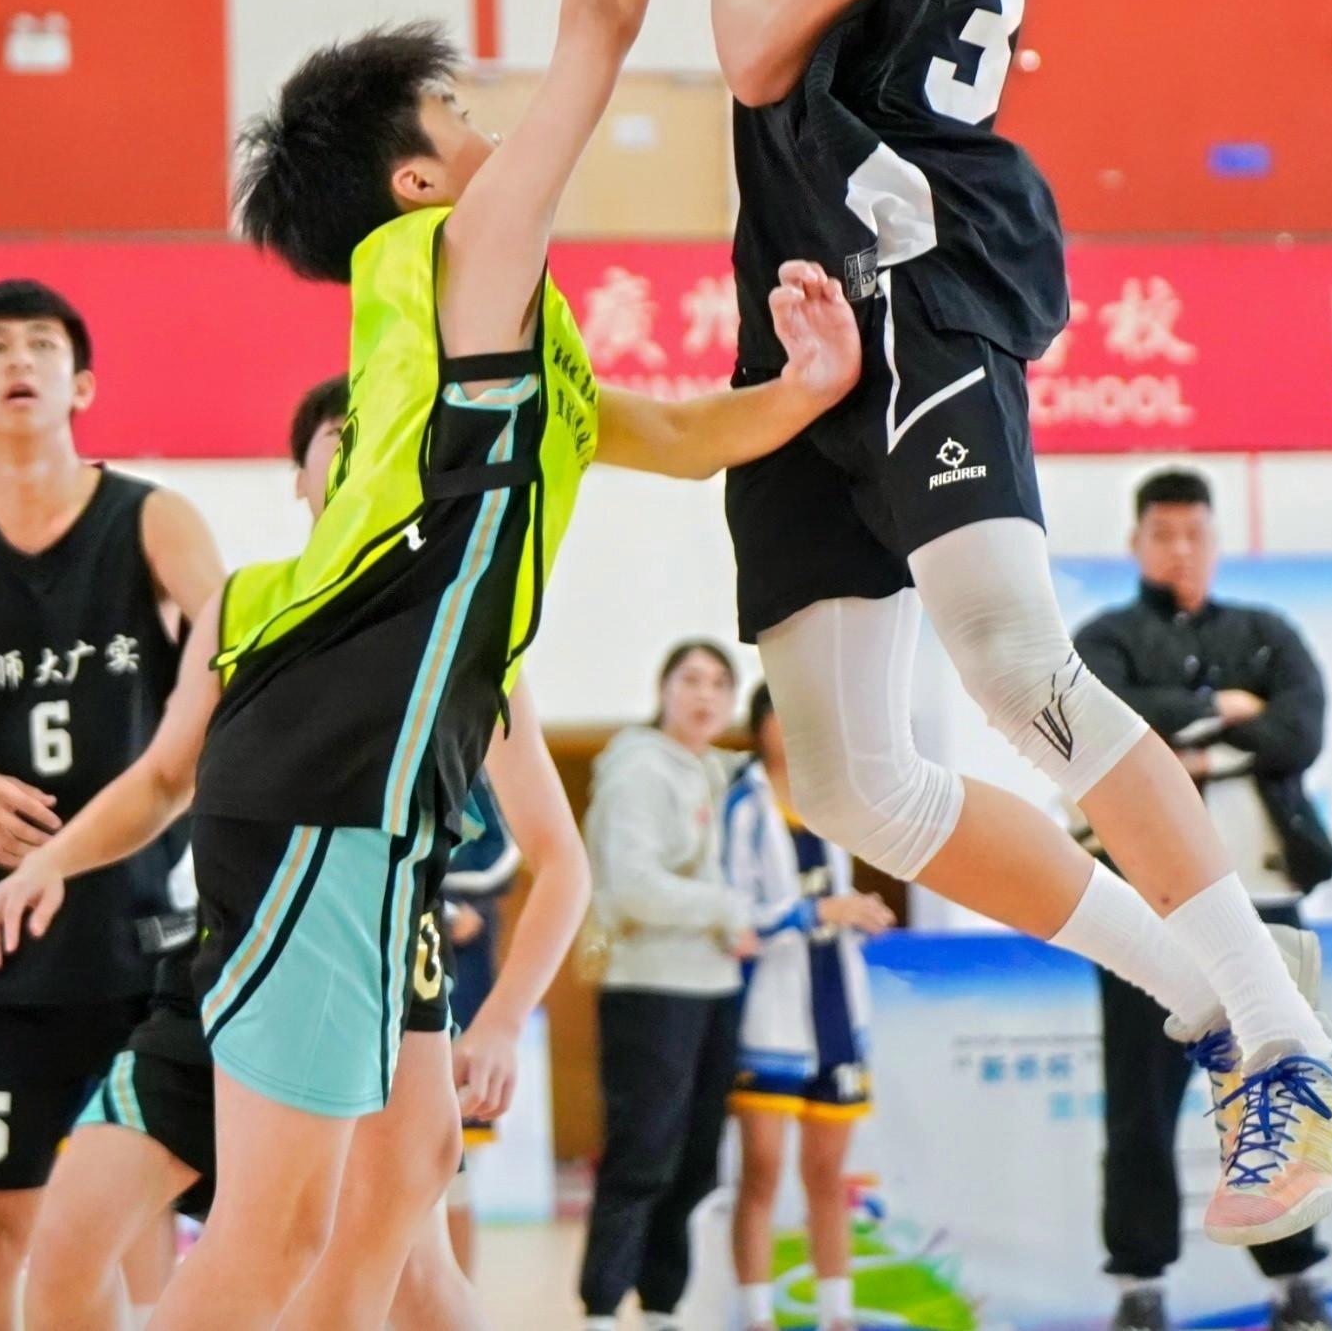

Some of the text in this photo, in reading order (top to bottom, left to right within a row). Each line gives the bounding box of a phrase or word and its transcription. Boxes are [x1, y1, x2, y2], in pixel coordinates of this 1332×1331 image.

[1029, 374, 1195, 425] CHOOL
[928, 465, 987, 490] RIGORER
[29, 699, 73, 777] 6
